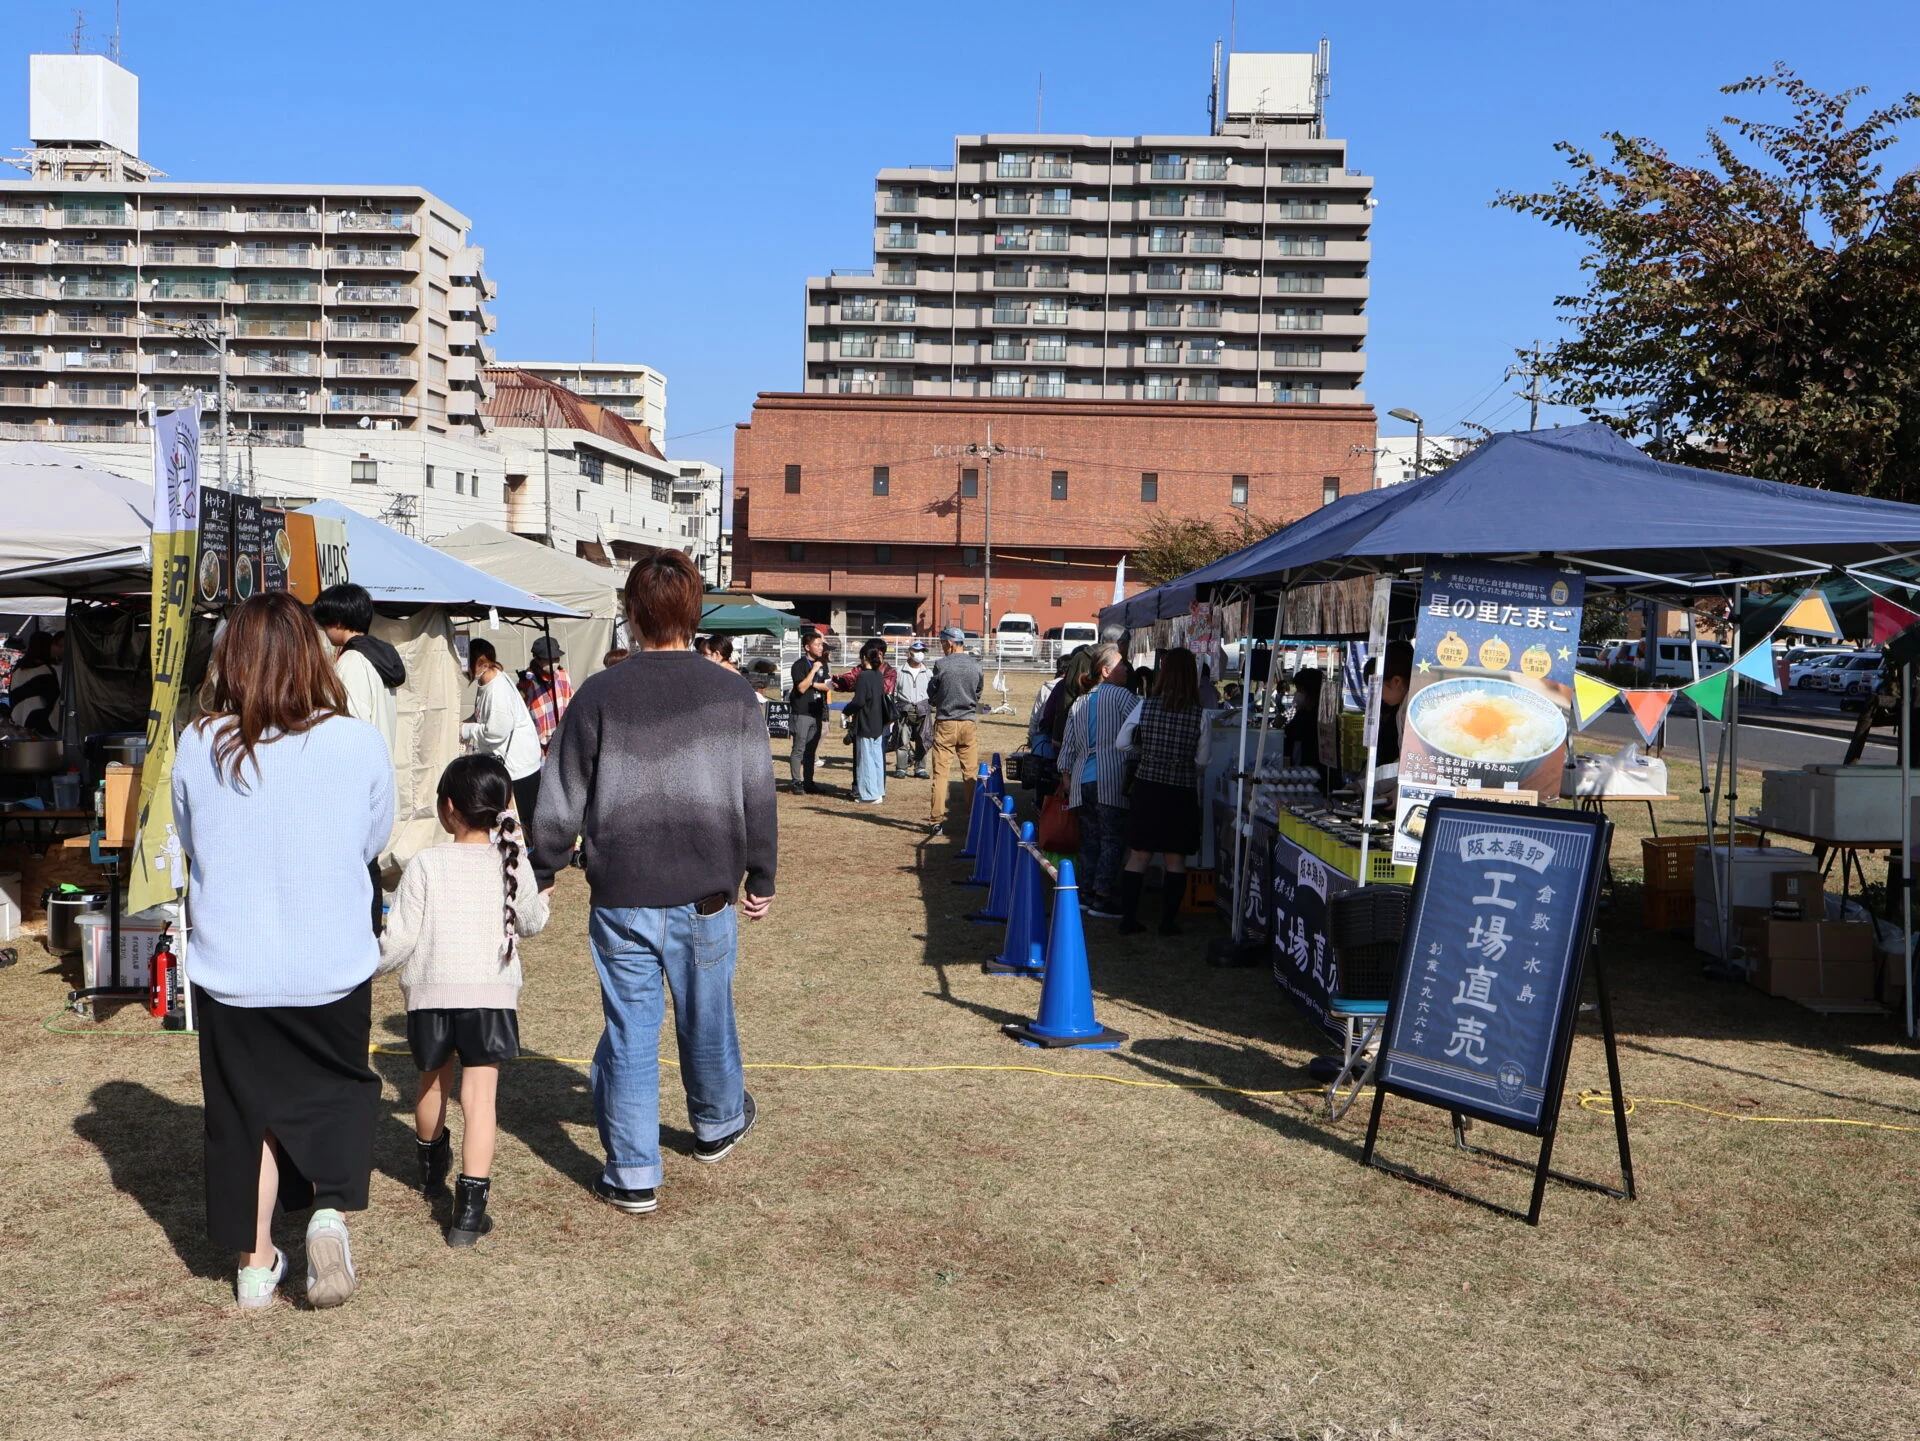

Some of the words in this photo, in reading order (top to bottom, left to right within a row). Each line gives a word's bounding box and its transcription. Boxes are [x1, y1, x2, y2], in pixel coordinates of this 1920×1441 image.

[1428, 593, 1574, 632] 星の里たまご
[1405, 761, 1469, 777] たまご一筋半世紀
[1467, 837, 1545, 865] 阪本鶏卵
[1443, 871, 1517, 1065] 工場直売
[1516, 884, 1556, 1005] 倉敷・水島
[1411, 941, 1443, 1045] 創業一九六六年
